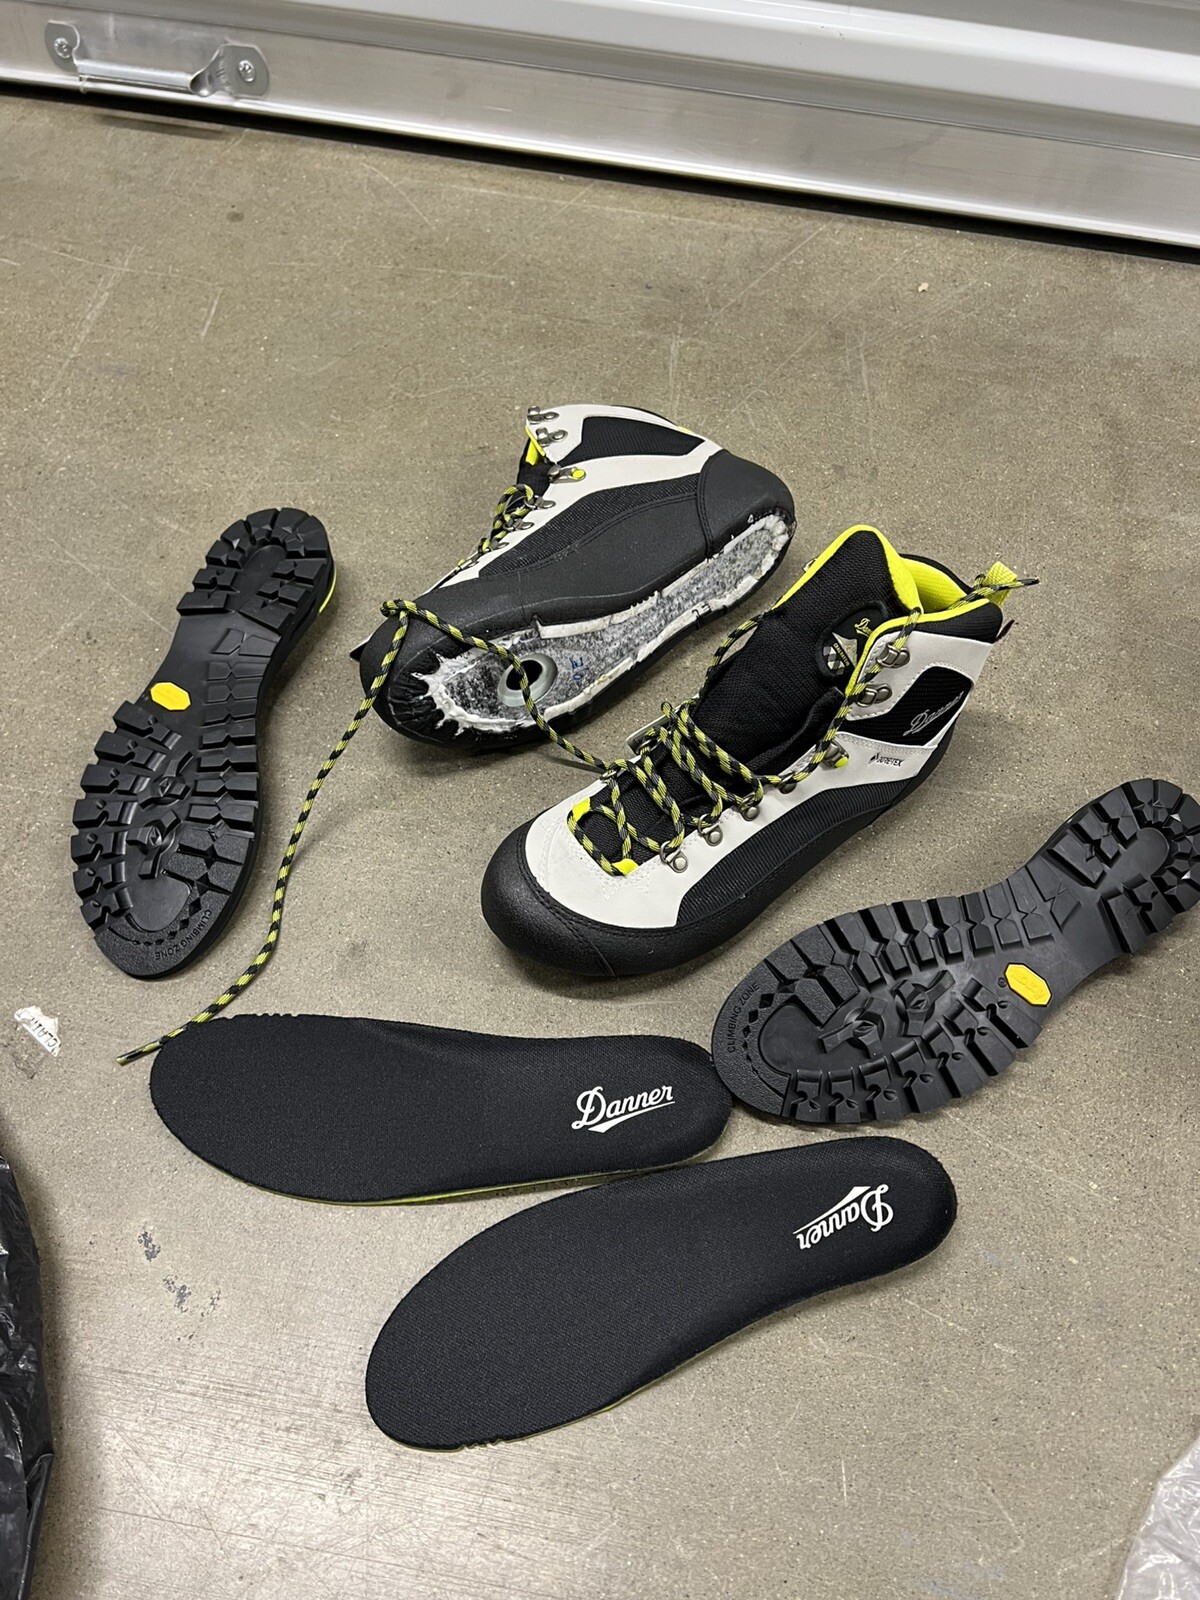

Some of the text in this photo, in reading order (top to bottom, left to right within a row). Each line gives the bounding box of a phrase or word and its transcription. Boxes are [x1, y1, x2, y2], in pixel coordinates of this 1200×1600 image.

[155, 909, 213, 961] CLIMBING ZONE
[727, 982, 760, 1053] CLIMBING ZONE
[571, 1085, 675, 1132] Danner
[795, 1184, 894, 1250] Danner
